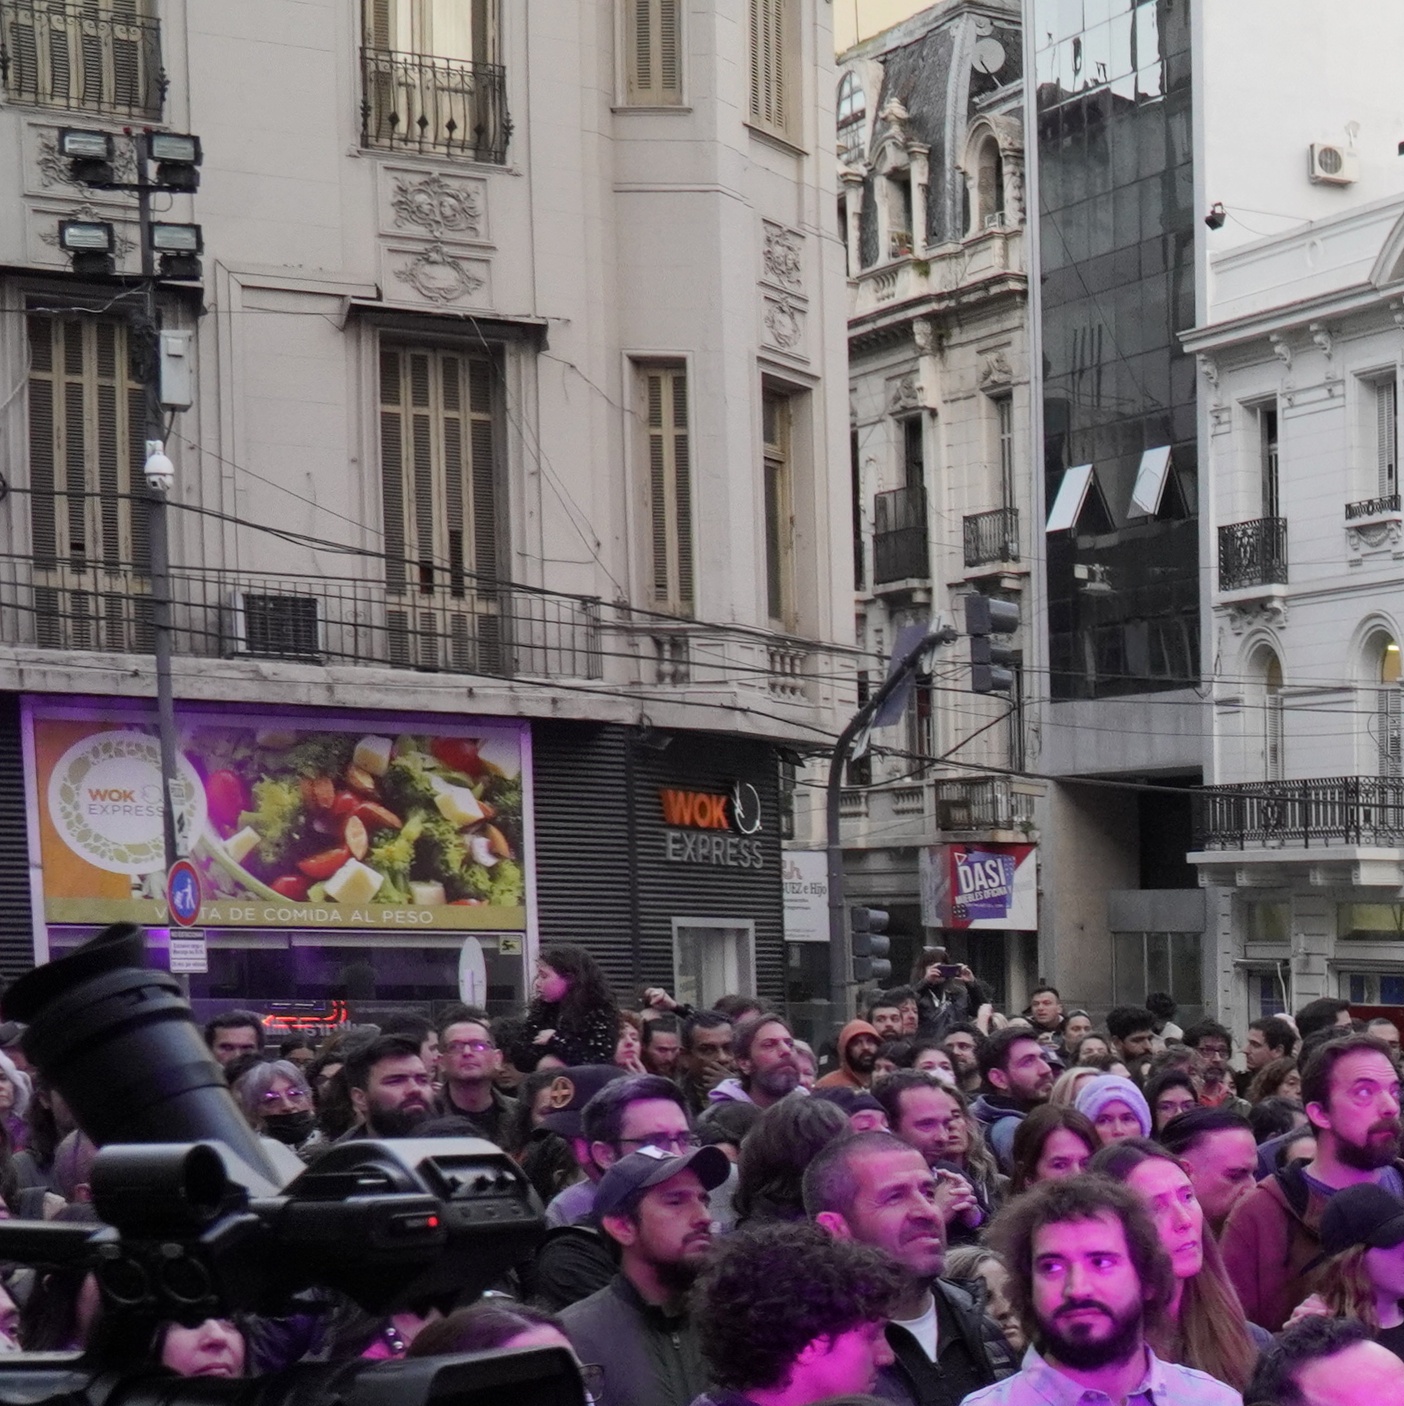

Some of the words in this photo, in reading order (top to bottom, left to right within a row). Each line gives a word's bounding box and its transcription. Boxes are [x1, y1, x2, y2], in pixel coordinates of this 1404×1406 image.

[87, 788, 137, 803] WOK
[661, 788, 730, 830] WOK
[665, 831, 764, 869] EXPRESS
[957, 858, 1007, 894] DASI
[155, 906, 222, 921] VTA
[229, 907, 257, 922] DE
[263, 908, 342, 923] COMIDA
[351, 909, 376, 923] AL
[382, 910, 433, 924] PESO
